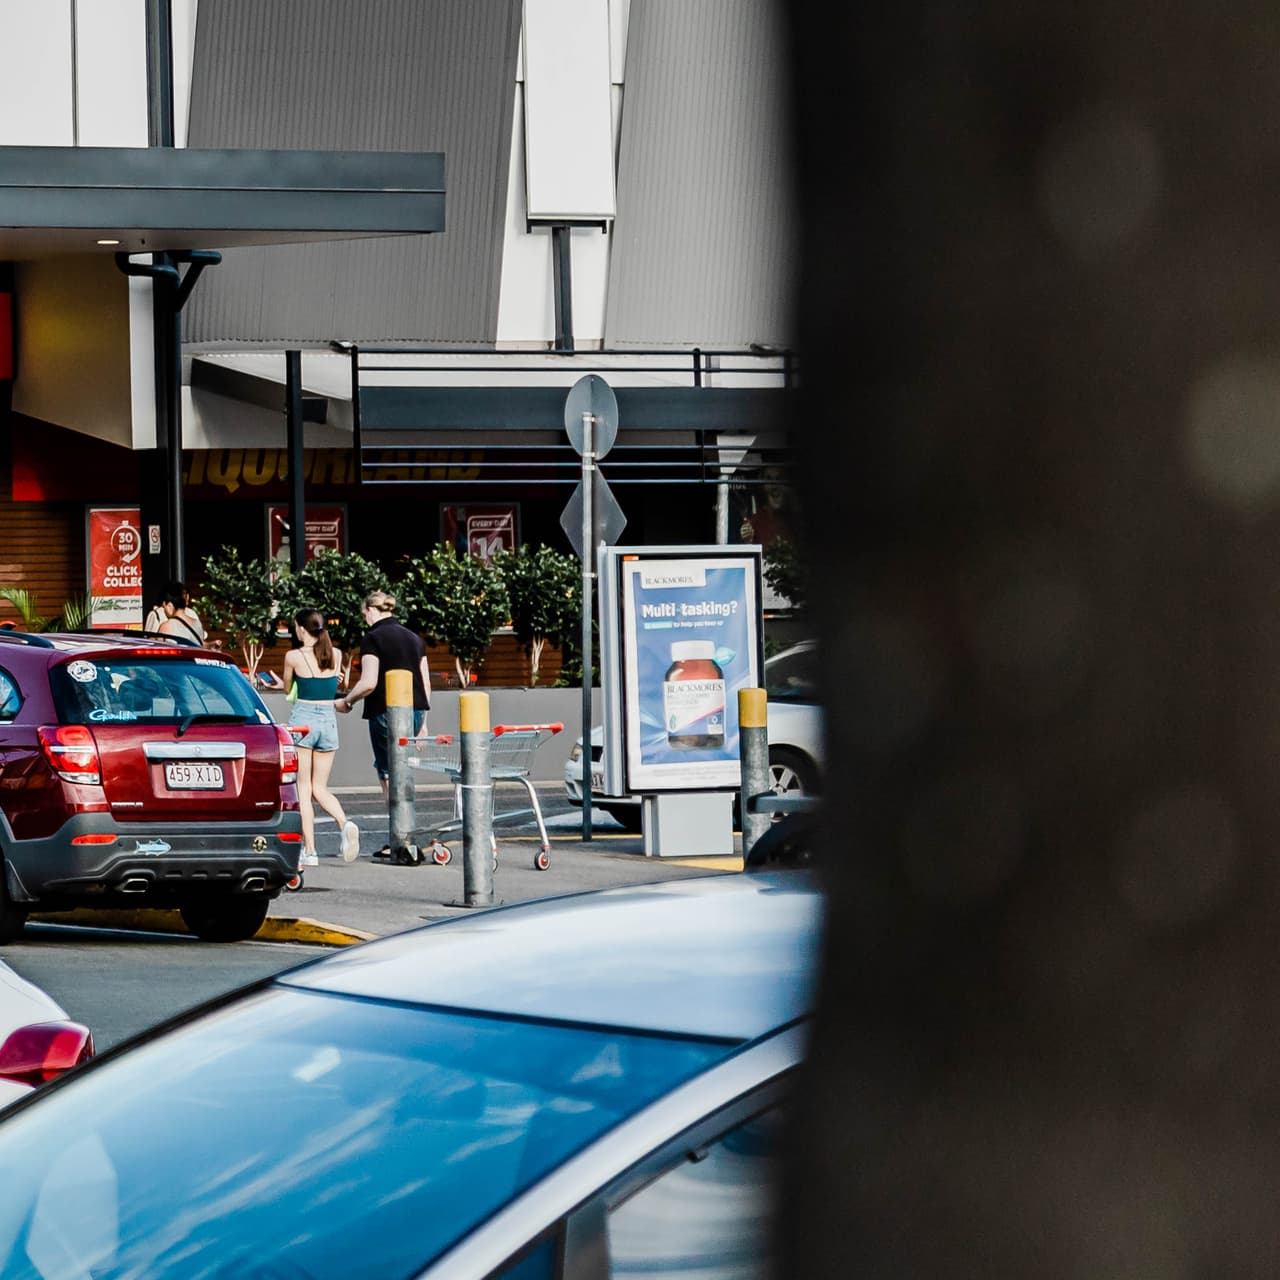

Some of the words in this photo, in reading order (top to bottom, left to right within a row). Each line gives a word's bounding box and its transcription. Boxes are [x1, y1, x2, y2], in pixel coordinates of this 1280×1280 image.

[119, 532, 134, 544] 30
[107, 566, 138, 577] CLICK
[104, 577, 143, 588] COLLEC
[169, 767, 191, 782] 459
[195, 767, 221, 782] XID
